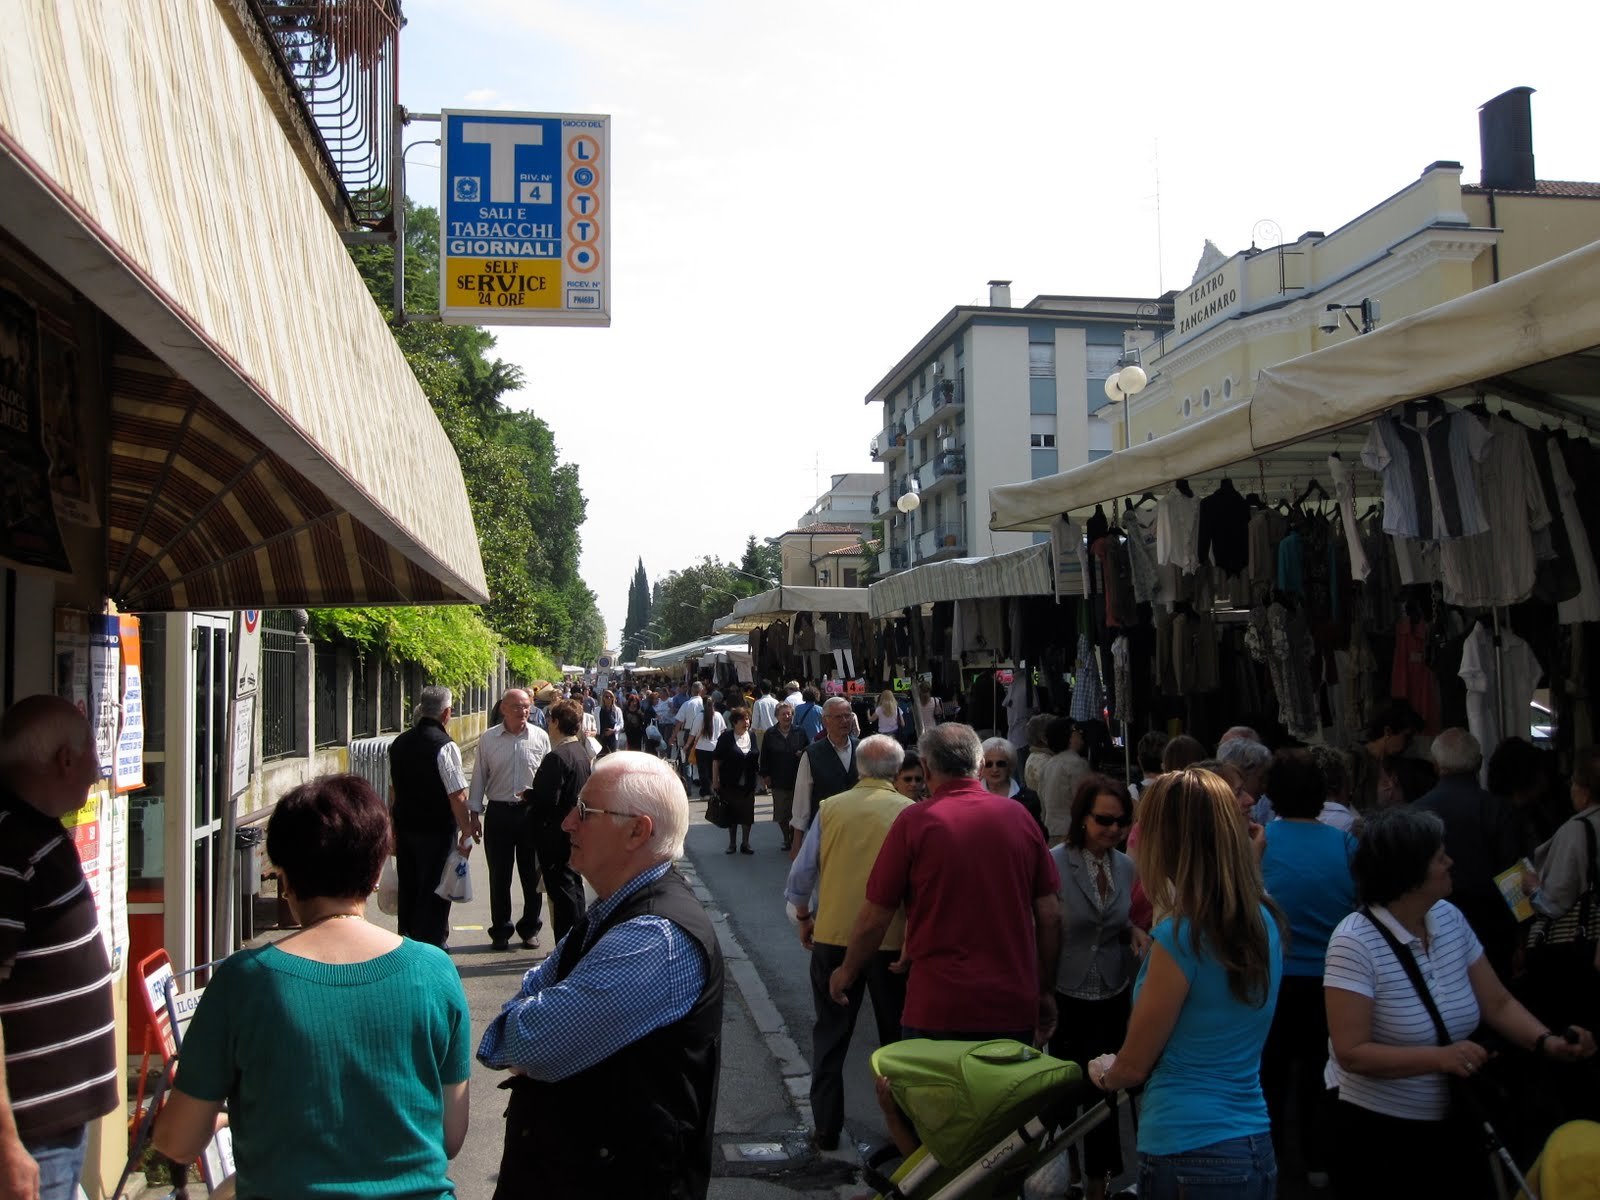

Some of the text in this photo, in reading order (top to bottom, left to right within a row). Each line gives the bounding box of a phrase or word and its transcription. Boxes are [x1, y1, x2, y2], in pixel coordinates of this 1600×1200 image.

[462, 122, 543, 203] T
[529, 186, 541, 201] 4
[479, 207, 527, 219] SALI E
[452, 222, 553, 238] TABACCHI
[450, 240, 553, 256] GIORNALI
[485, 260, 519, 274] SELF
[457, 274, 546, 292] SERVICE
[1189, 273, 1224, 306] TEATRO
[478, 292, 525, 307] 24 ORE
[1180, 289, 1236, 334] ZANCANARO
